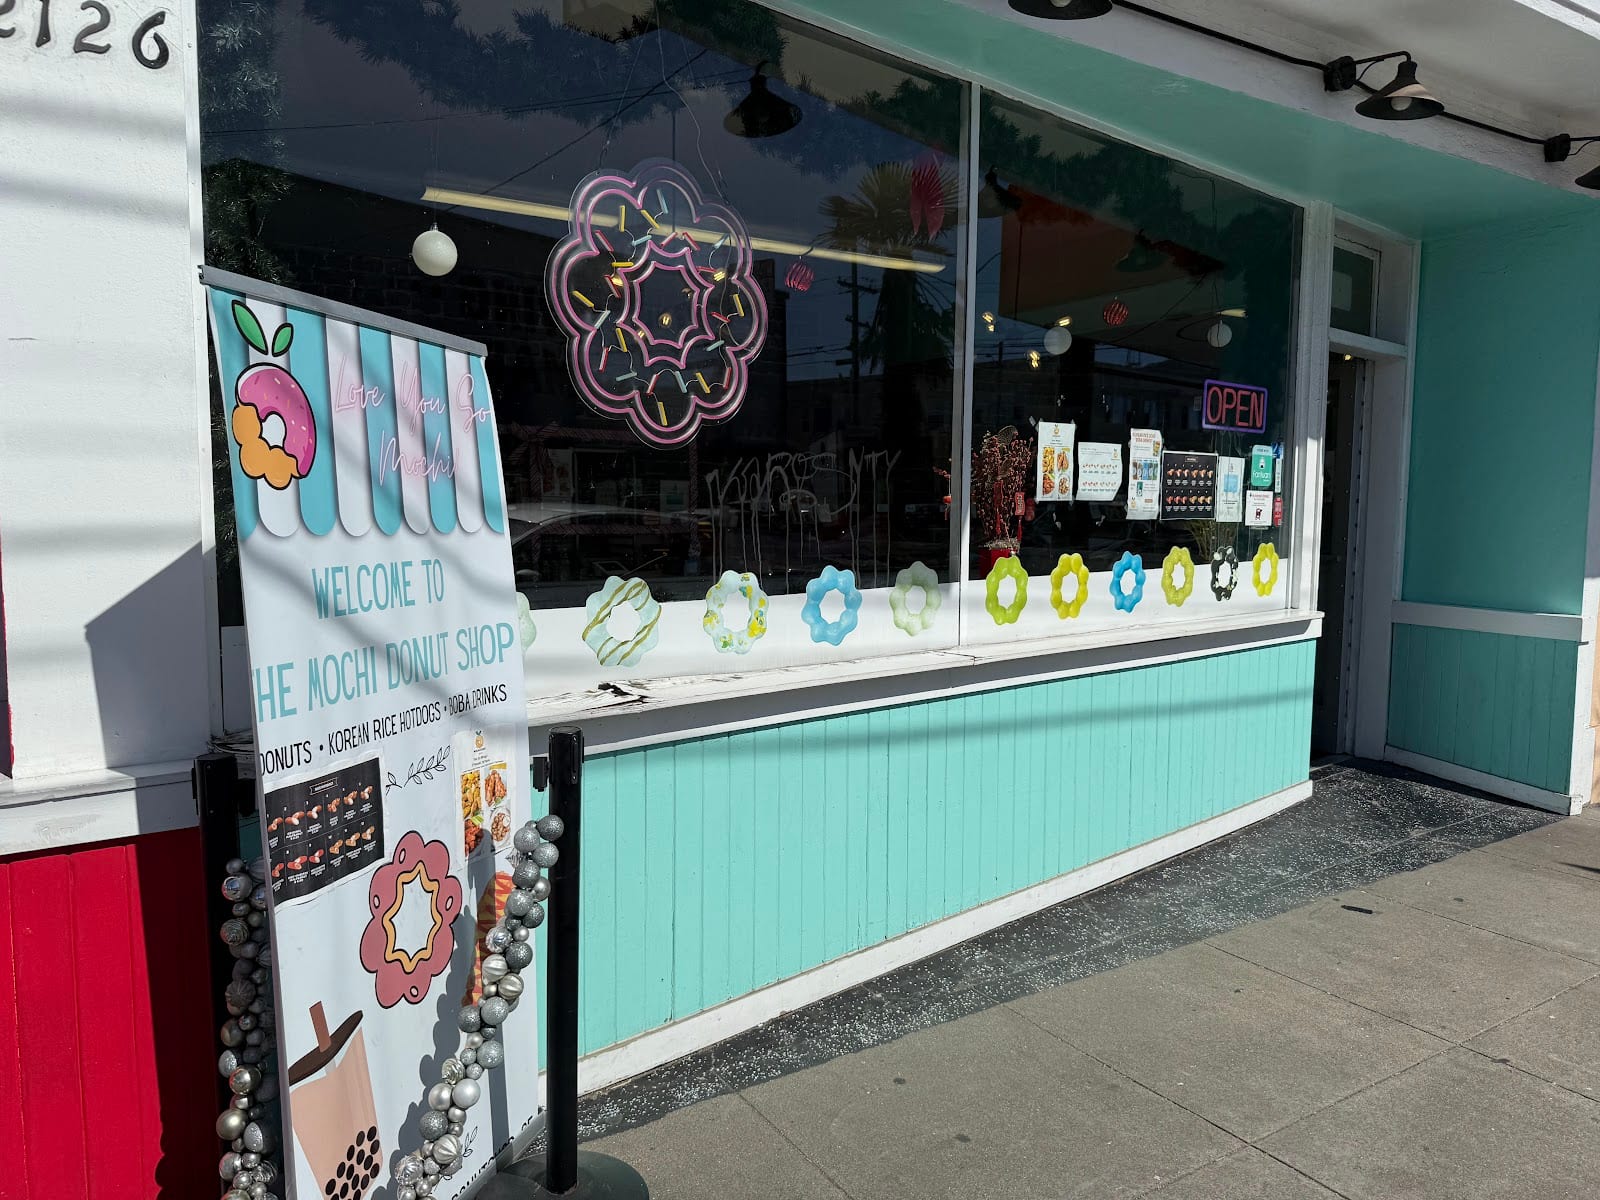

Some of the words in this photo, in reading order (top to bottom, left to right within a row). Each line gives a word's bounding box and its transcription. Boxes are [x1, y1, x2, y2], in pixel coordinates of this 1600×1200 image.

[336, 355, 386, 412] Love
[400, 361, 446, 437] You
[457, 373, 492, 433] So
[1206, 386, 1265, 428] OPEN
[312, 560, 416, 620] WELCOME
[422, 558, 445, 604] TO
[253, 662, 297, 723] HE
[308, 646, 378, 711] MOCHI
[386, 631, 448, 690] DONUT
[455, 622, 514, 671] SHOP
[328, 721, 370, 756] KOREAN
[373, 713, 398, 741] RICE
[399, 701, 441, 733] HOTDOGS
[449, 692, 471, 716] BOBA
[472, 684, 507, 710] DRINKS
